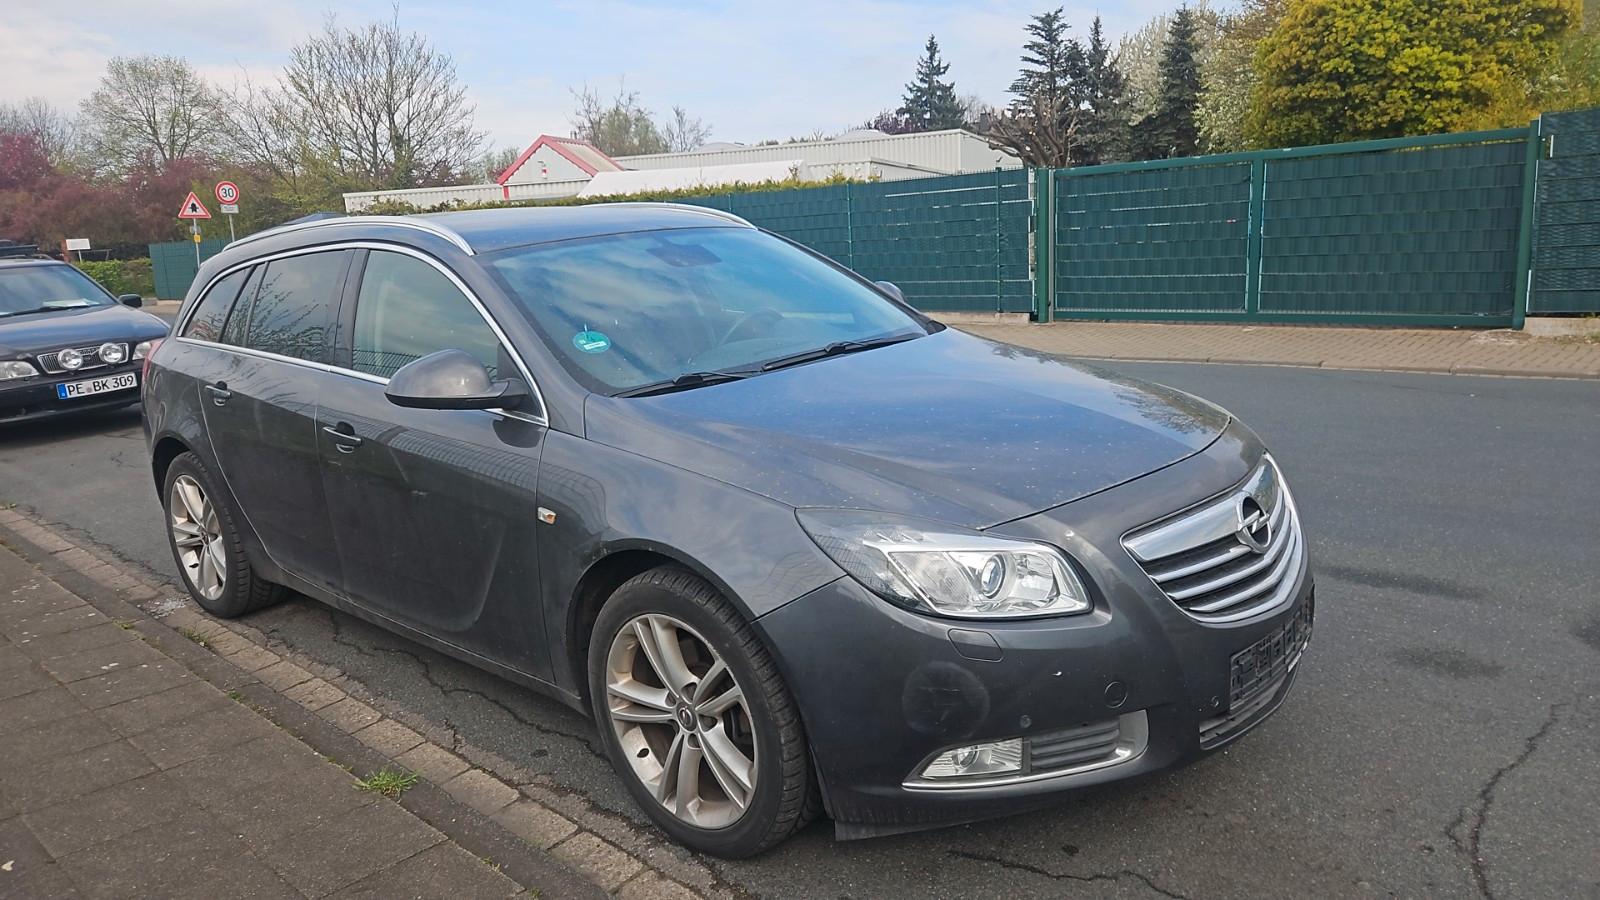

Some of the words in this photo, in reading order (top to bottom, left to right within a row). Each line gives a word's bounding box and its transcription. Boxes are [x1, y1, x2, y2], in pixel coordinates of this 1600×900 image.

[221, 188, 234, 198] 30
[67, 383, 85, 396] PE
[92, 379, 110, 392] BK
[112, 375, 134, 388] 309
